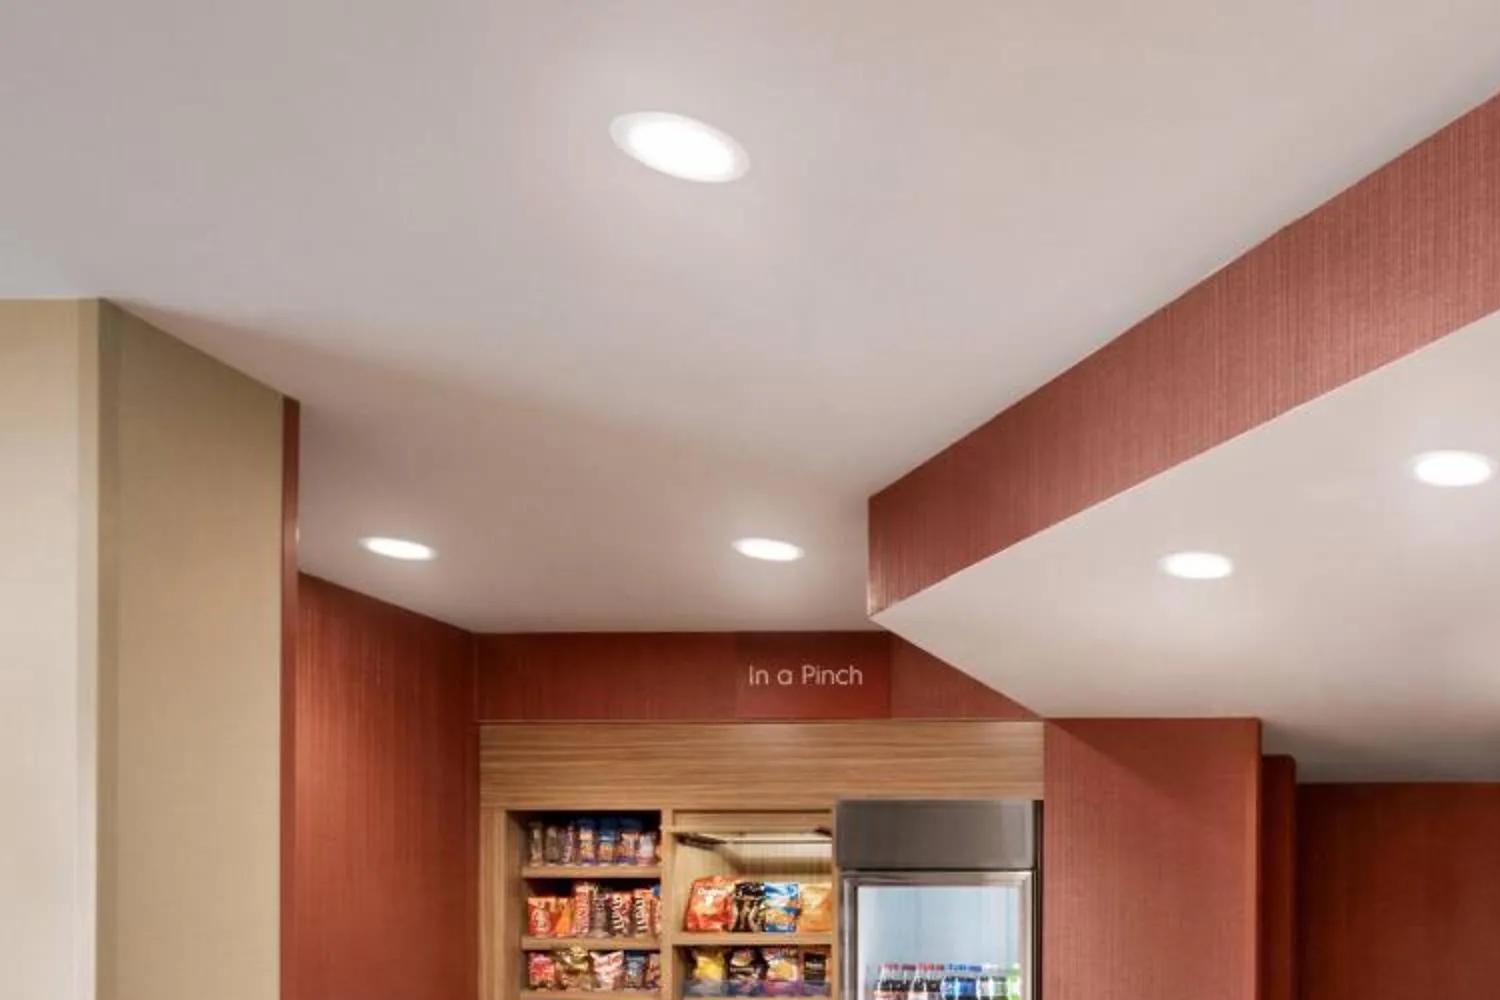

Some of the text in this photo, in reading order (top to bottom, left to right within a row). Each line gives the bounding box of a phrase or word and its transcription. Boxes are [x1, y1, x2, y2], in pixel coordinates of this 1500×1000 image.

[748, 664, 864, 686] In a Pinch
